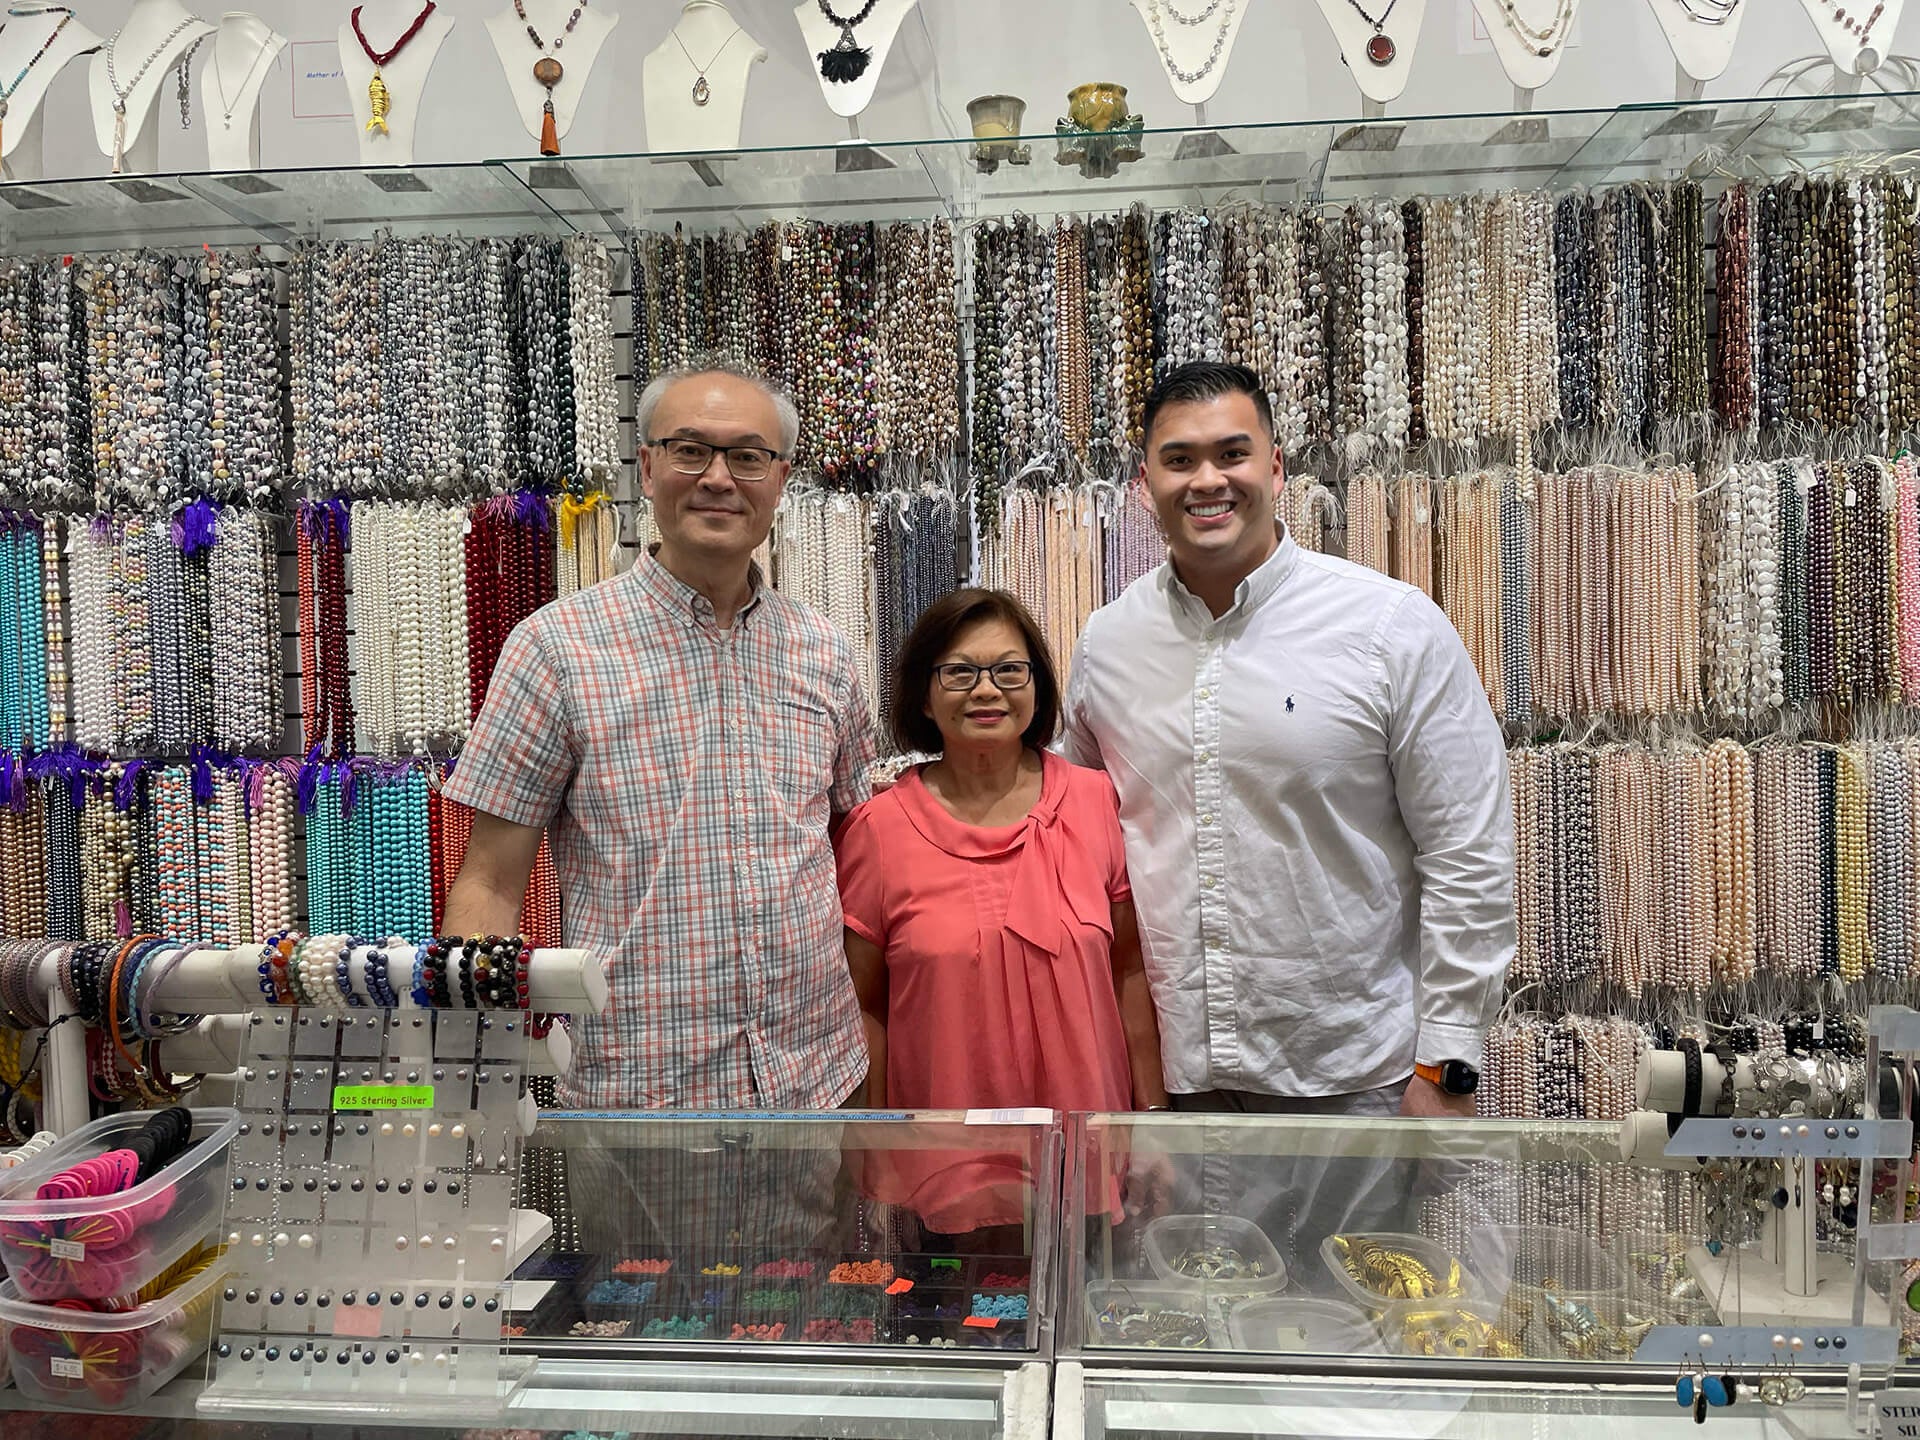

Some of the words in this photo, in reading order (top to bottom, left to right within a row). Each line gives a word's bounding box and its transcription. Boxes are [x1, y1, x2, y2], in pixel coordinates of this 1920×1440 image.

[340, 1096, 357, 1105] 925
[361, 1095, 398, 1107] Sterling
[401, 1095, 427, 1105] Silver
